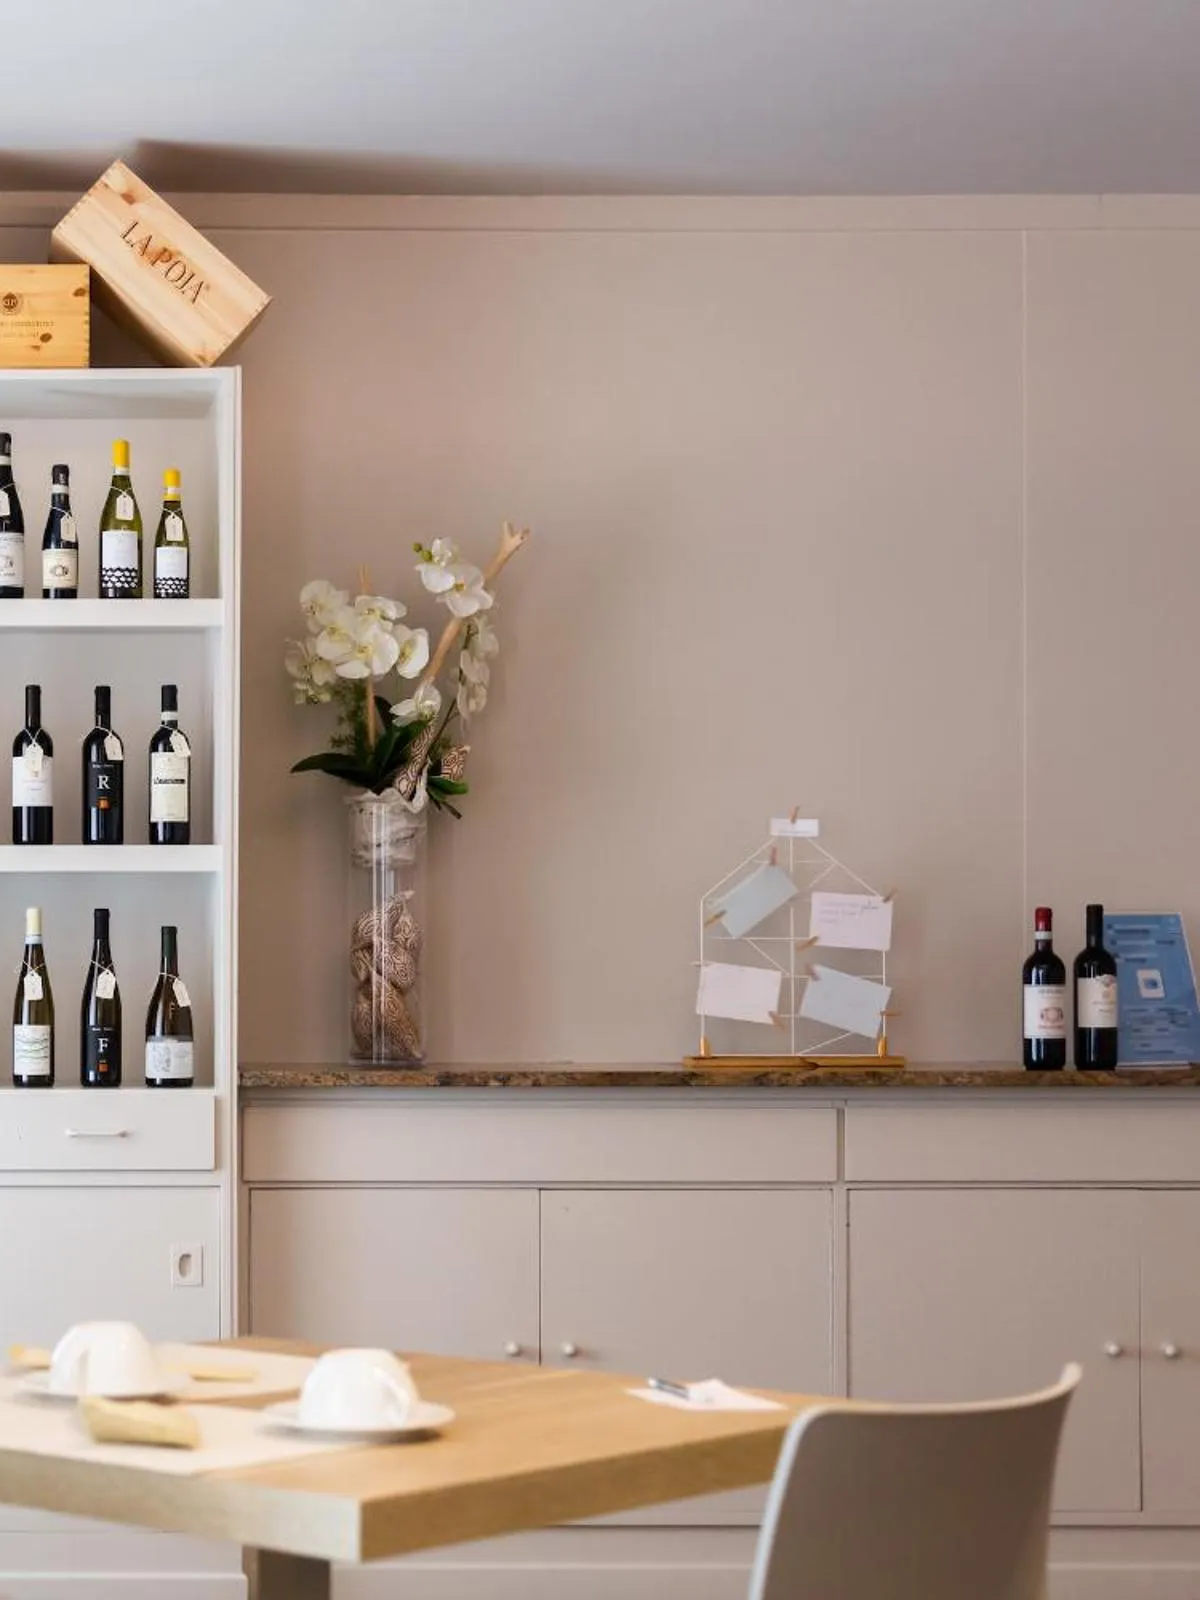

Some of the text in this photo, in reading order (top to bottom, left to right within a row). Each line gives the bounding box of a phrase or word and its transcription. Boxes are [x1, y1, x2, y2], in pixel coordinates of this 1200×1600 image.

[119, 220, 153, 258] LA
[97, 775, 110, 790] R
[97, 1037, 109, 1053] F
